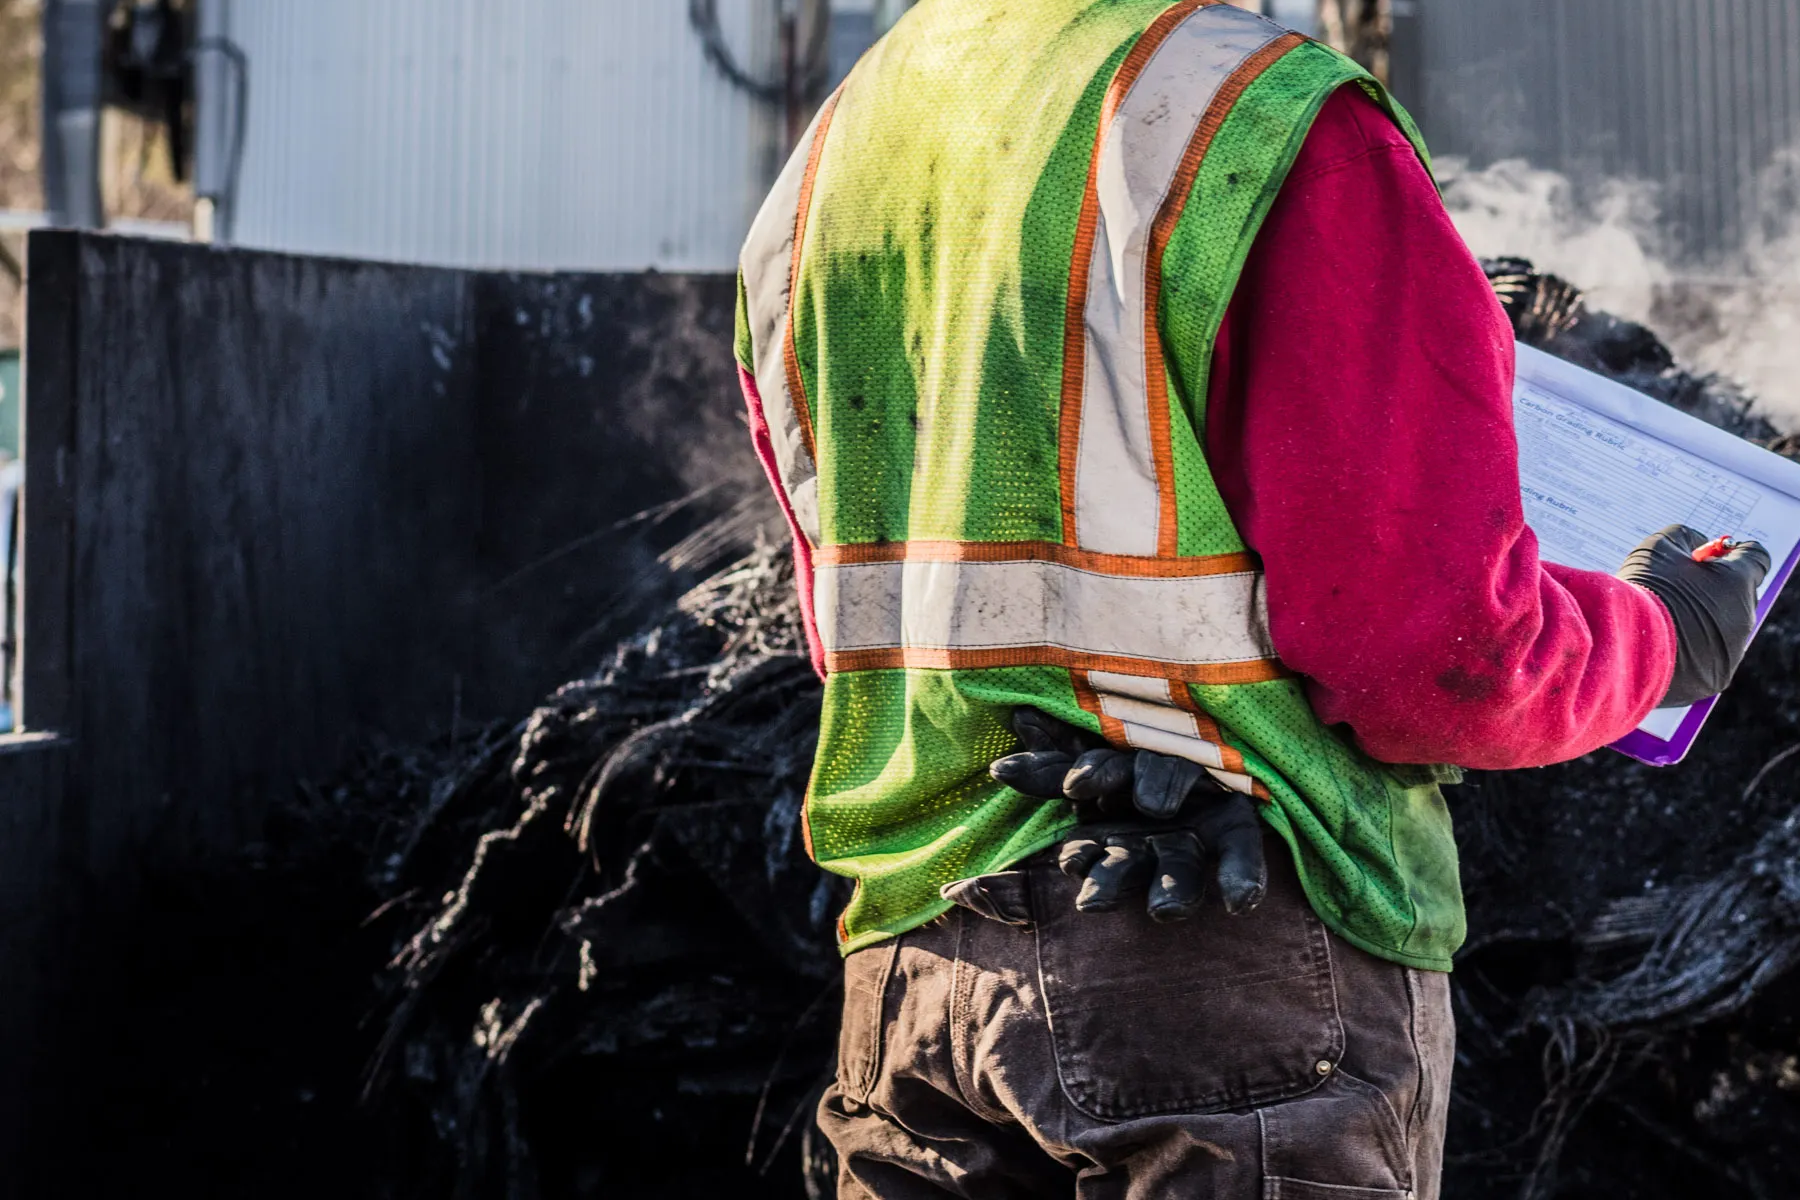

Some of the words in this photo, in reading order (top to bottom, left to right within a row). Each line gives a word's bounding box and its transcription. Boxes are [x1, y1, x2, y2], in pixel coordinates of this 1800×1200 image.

[1519, 397, 1554, 416] Carbon
[1556, 414, 1593, 436] Grading
[1596, 432, 1626, 451] Rubric
[1520, 485, 1545, 502] ding
[1546, 496, 1578, 515] Rubric
